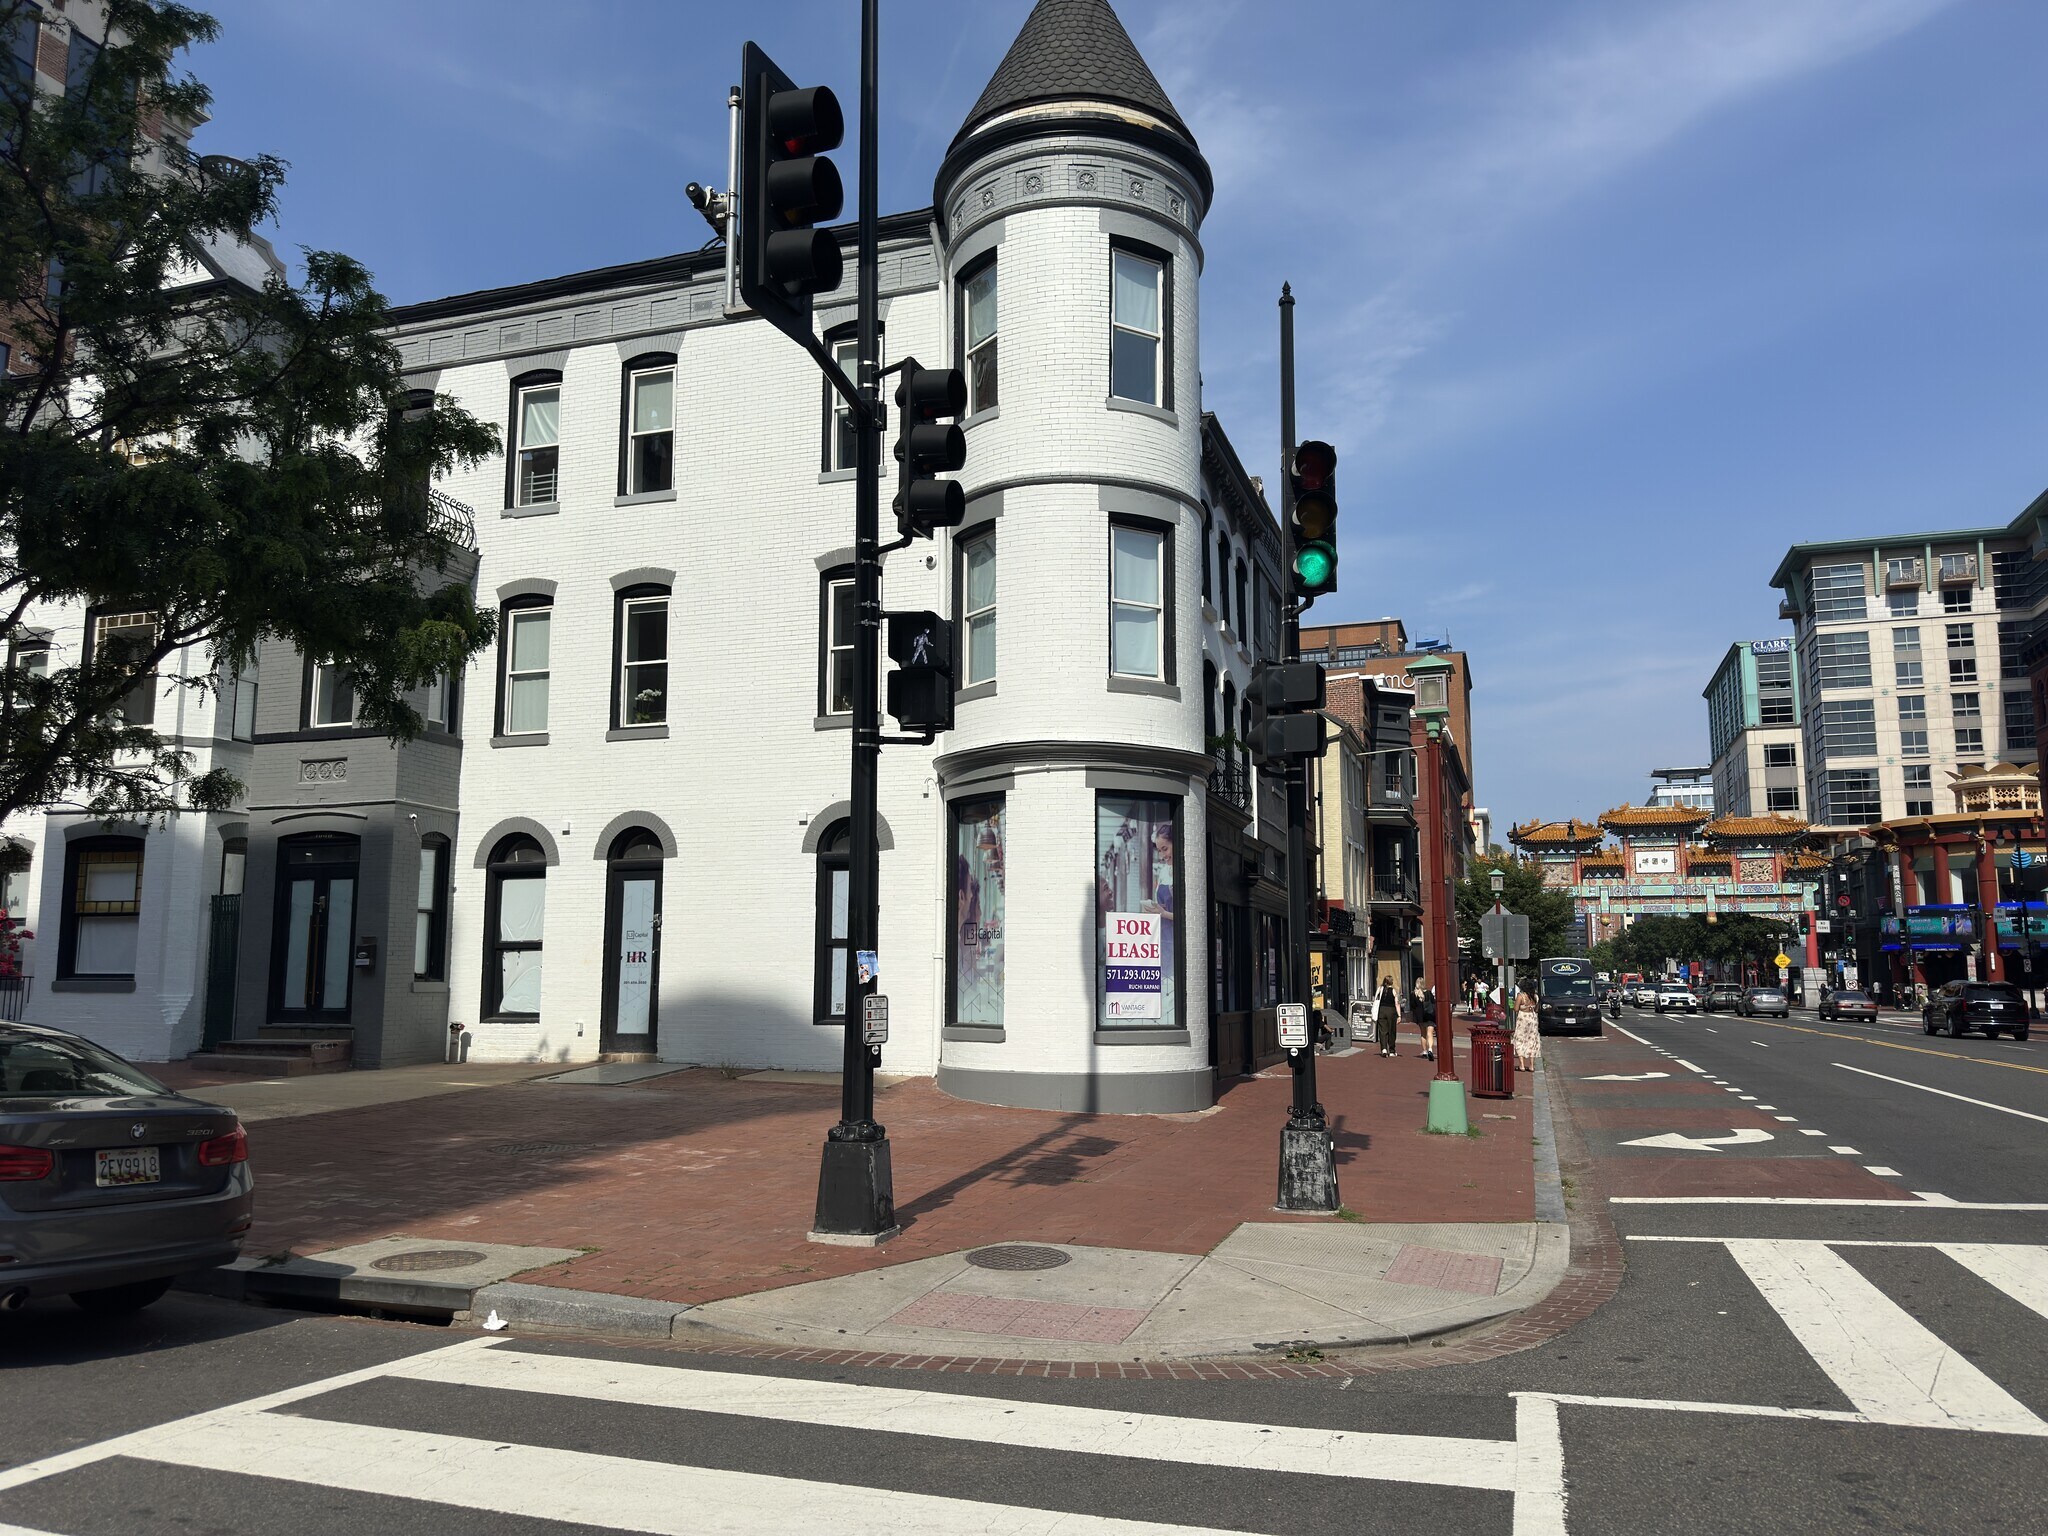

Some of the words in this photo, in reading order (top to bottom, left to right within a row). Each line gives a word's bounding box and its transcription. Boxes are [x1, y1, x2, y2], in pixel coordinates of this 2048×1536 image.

[1753, 640, 1788, 649] CLARK
[978, 927, 1003, 942] Capital
[1116, 919, 1152, 935] FOR
[1107, 943, 1160, 959] LEASE
[1106, 969, 1160, 981] 571.293.0259
